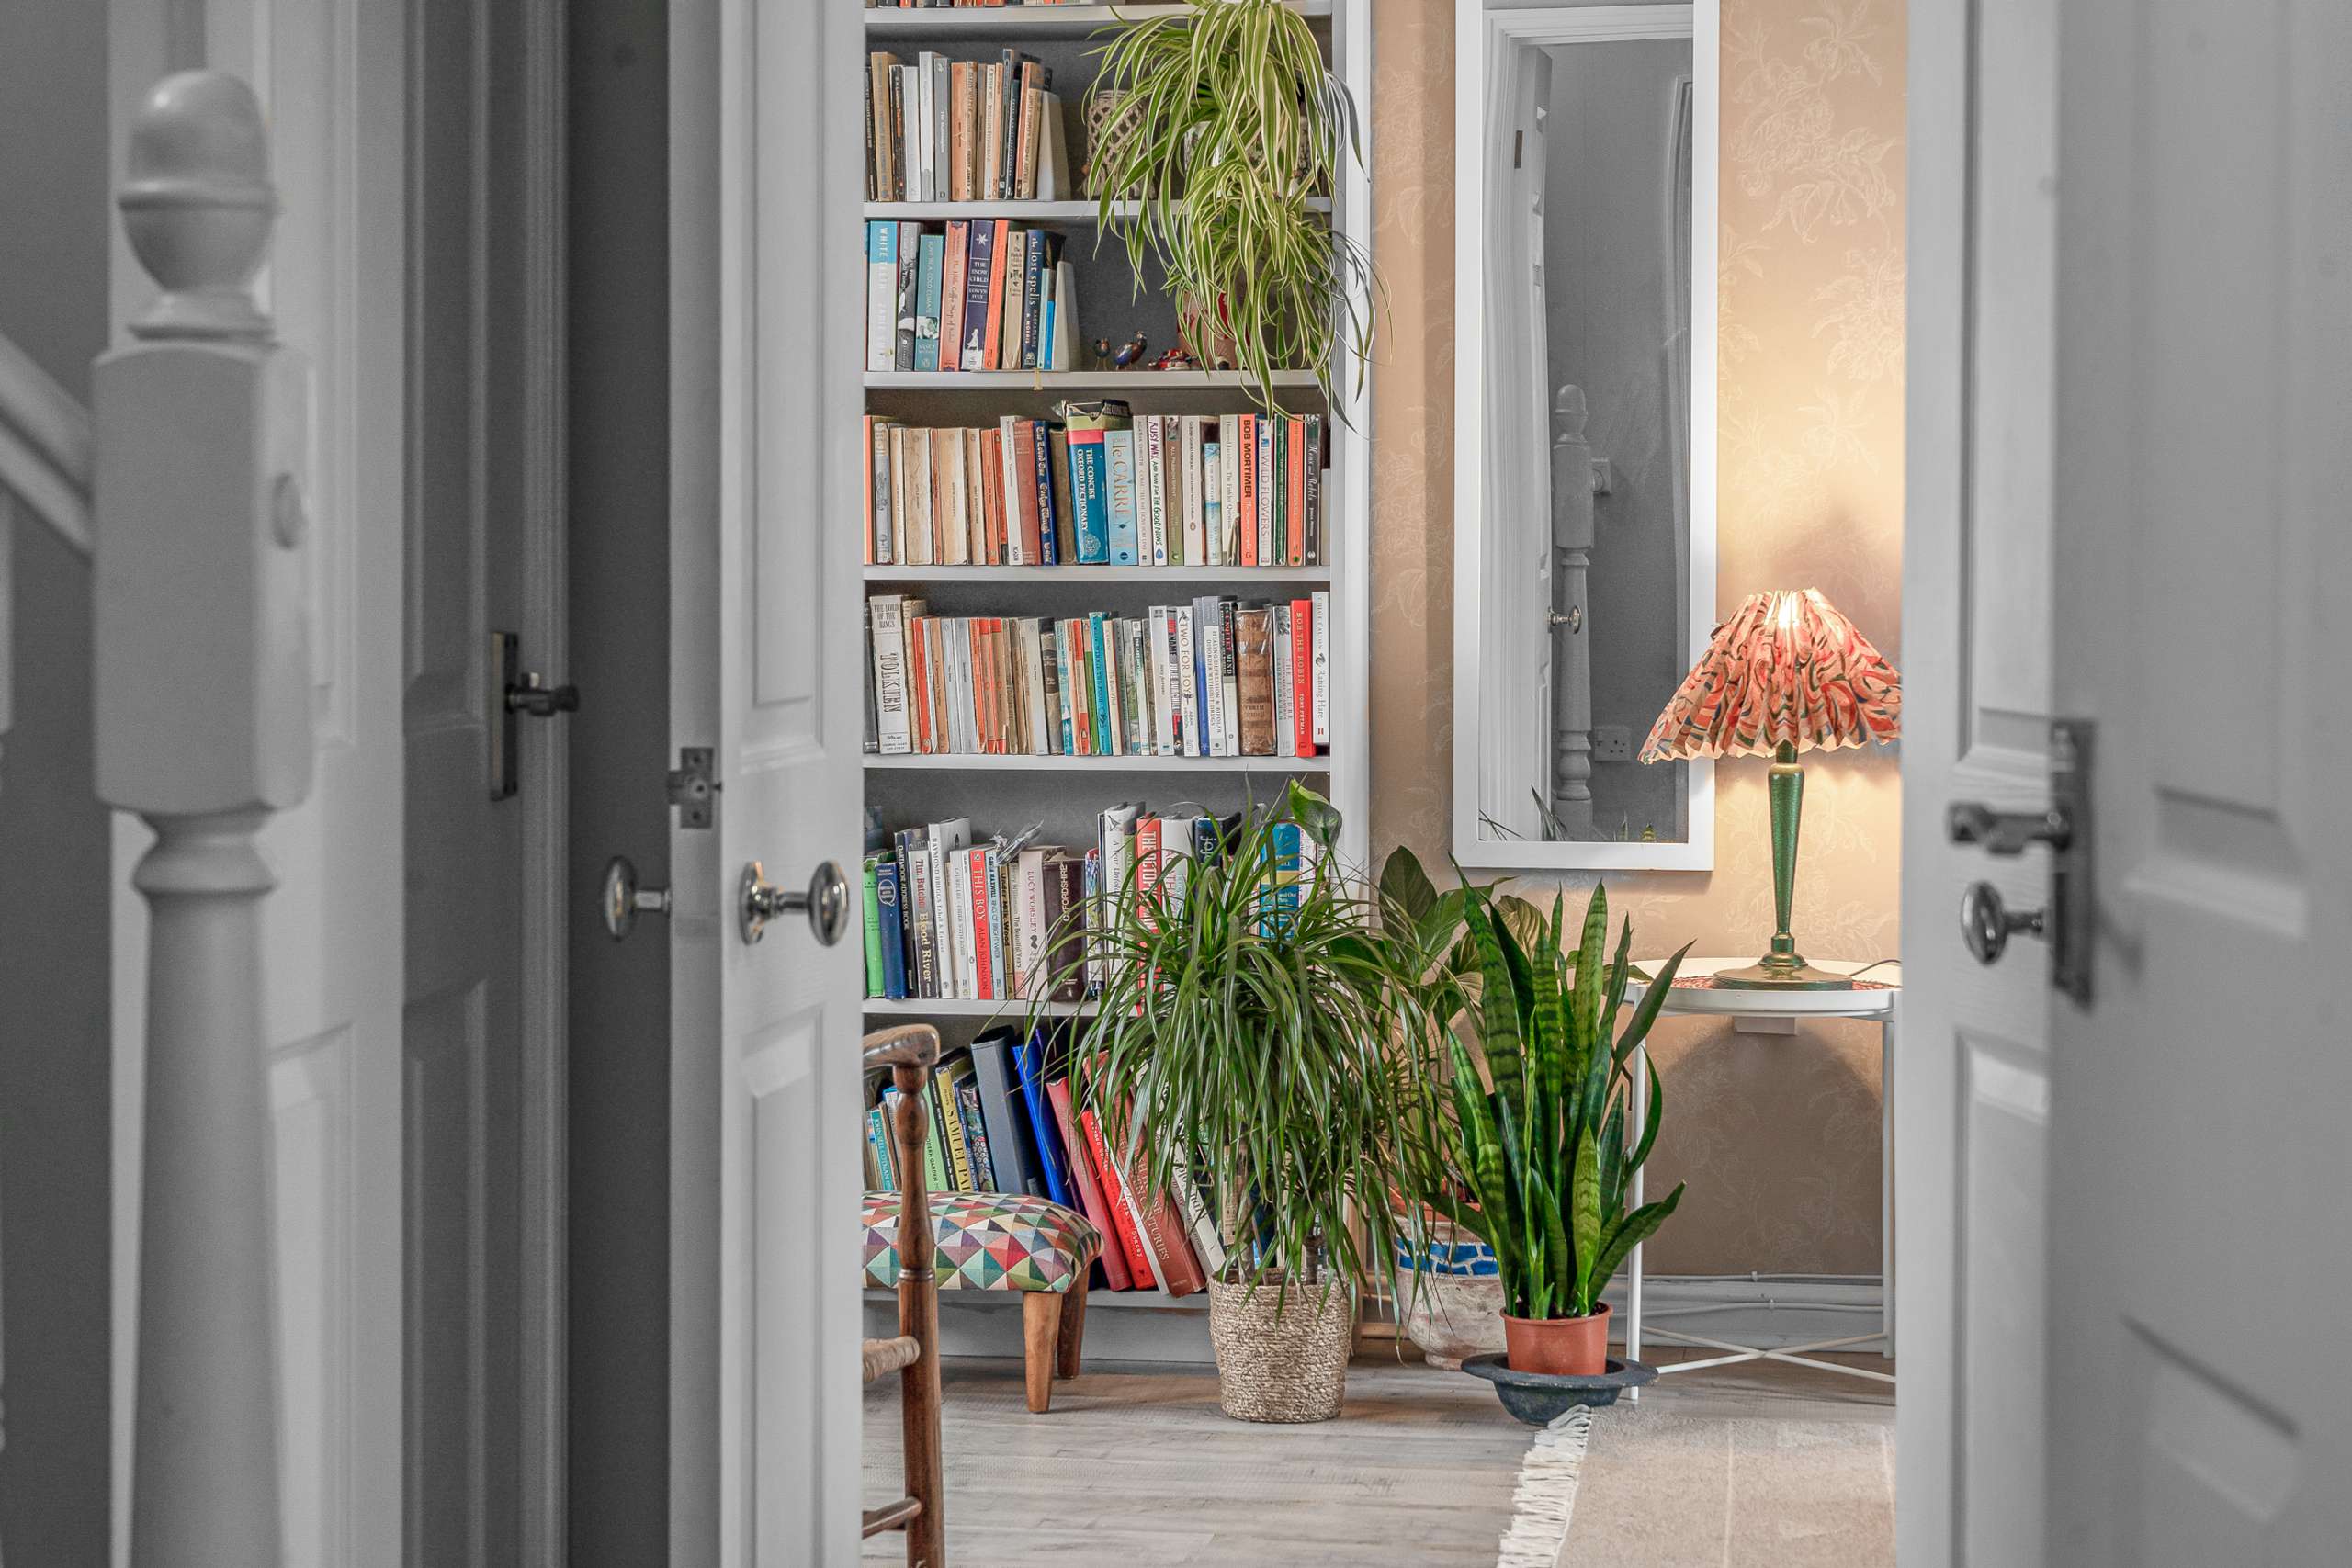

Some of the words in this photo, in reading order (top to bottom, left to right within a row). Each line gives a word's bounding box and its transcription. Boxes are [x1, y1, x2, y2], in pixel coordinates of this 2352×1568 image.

[880, 227, 888, 258] WHITE
[1031, 251, 1041, 271] lost
[949, 287, 957, 302] Coffee
[1027, 275, 1040, 306] spells
[947, 305, 956, 318] Shop
[1149, 422, 1159, 442] RUBY
[1243, 419, 1252, 440] BOB
[1112, 445, 1128, 457] le
[1150, 444, 1159, 460] WAX
[1308, 444, 1317, 465] Hons
[1078, 449, 1086, 482] OXFORD
[1244, 443, 1252, 498] MORTIMER
[1087, 465, 1096, 499] CONCISE
[1308, 478, 1317, 500] Rebels
[1039, 483, 1049, 508] Evelyn
[1079, 484, 1089, 531] DICTIONARY
[1040, 508, 1050, 534] Waugh
[1153, 507, 1162, 527] GOOD
[1261, 486, 1269, 536] FLOWERS
[1155, 527, 1163, 546] NEWS
[885, 603, 899, 611] LORD
[879, 620, 895, 629] RINGS
[1180, 623, 1189, 647] TWO
[1169, 636, 1177, 656] NAME
[880, 653, 902, 713] TOLKIEN
[1170, 663, 1179, 679] JULIE
[1316, 670, 1325, 698] Raising
[1171, 681, 1180, 710] BURCHILL
[1182, 675, 1191, 694] JOY
[1142, 830, 1156, 851] THE
[898, 845, 906, 882] DARTMOOR
[916, 859, 925, 875] Tim
[973, 868, 984, 895] THIS
[1176, 874, 1184, 896] Lucy
[900, 883, 908, 910] ADDRESS
[976, 899, 986, 922] BOY
[1029, 894, 1038, 933] WORSLEY
[918, 912, 929, 945] Blood
[1003, 921, 1011, 947] Wood
[922, 950, 932, 981] River
[979, 950, 988, 991] JOHNSON
[948, 1109, 965, 1164] SAMUEL
[880, 1150, 890, 1180] COTMAN
[1141, 1195, 1169, 1260] CNTURIES
[1131, 1231, 1143, 1258] Stacey
